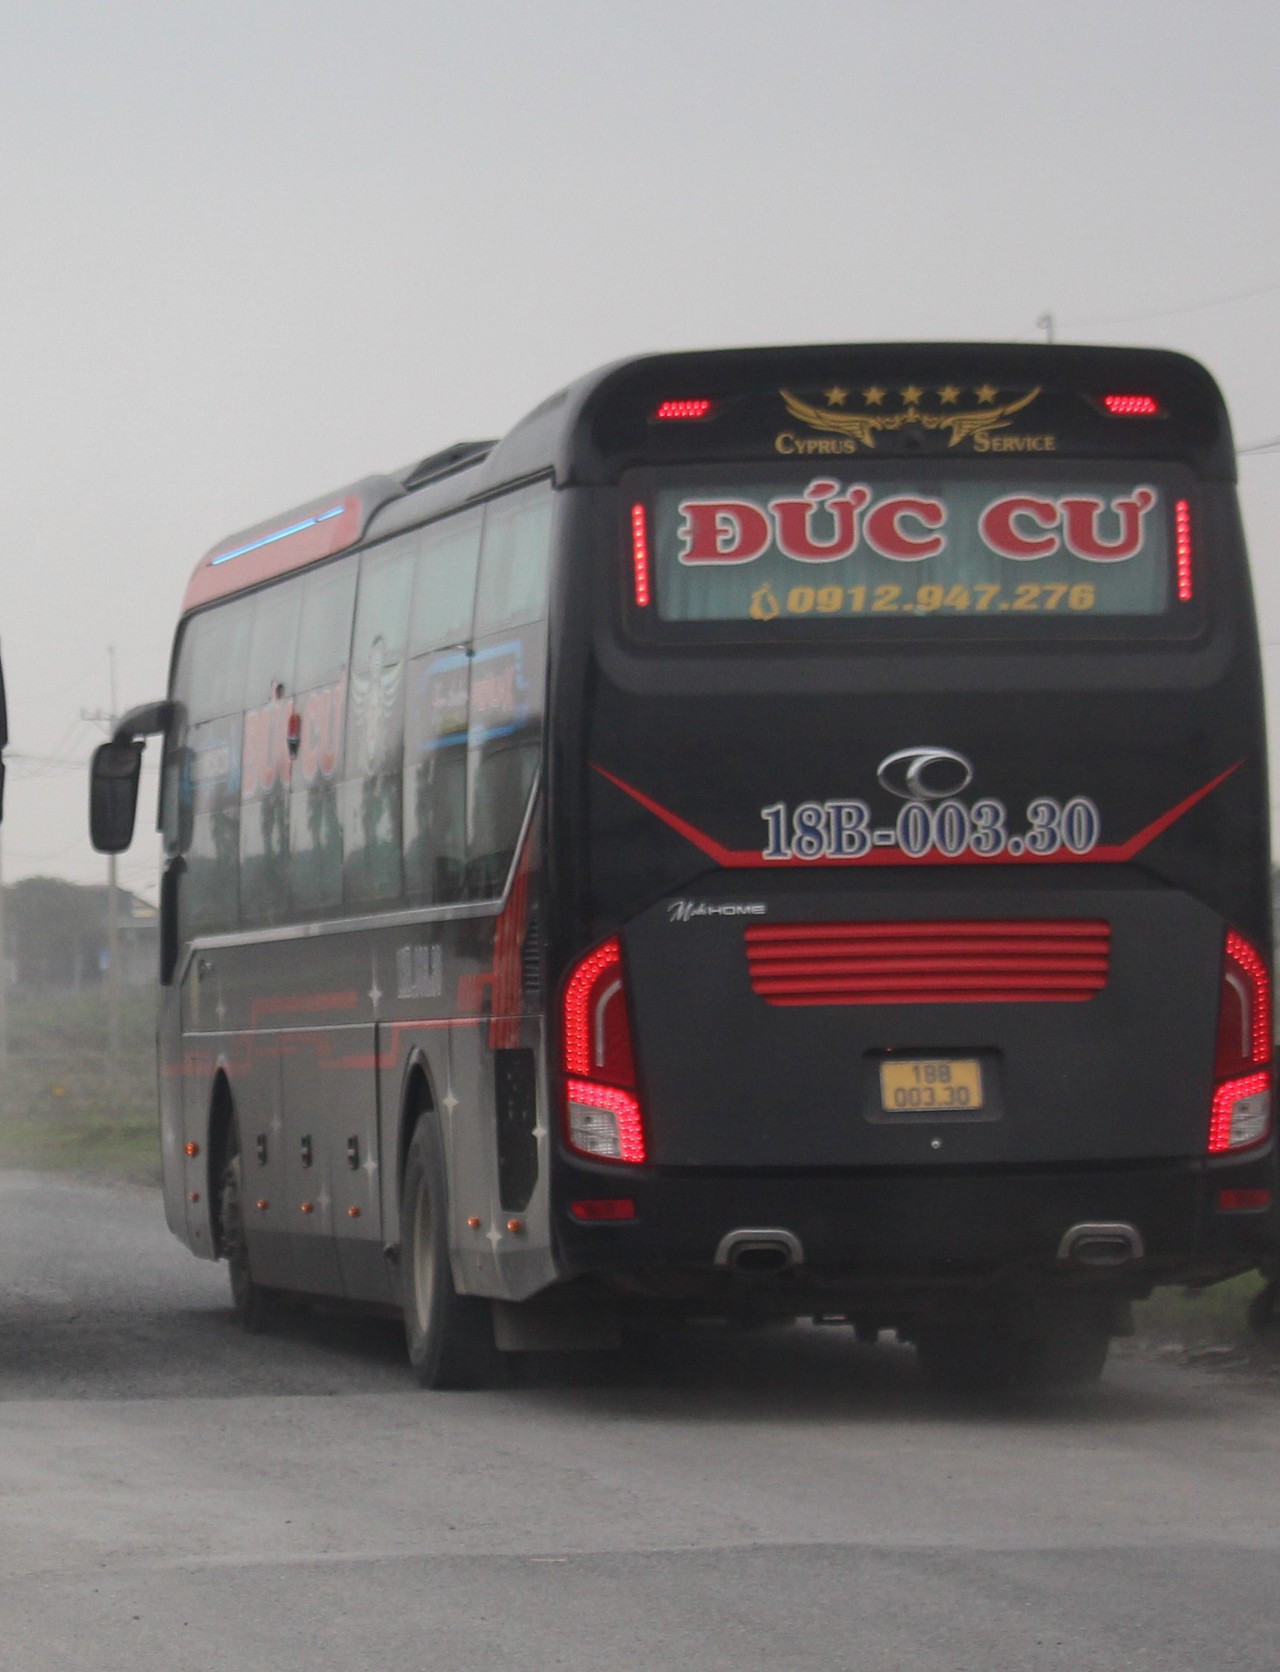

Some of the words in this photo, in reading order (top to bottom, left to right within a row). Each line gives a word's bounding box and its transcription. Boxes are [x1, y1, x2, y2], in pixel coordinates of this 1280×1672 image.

[677, 476, 947, 566] ĐỨC
[978, 484, 1156, 564] CƯ
[786, 582, 1097, 614] 0912.947.276
[761, 798, 1100, 860] 18B-003.30
[893, 1086, 971, 1107] 003.30
